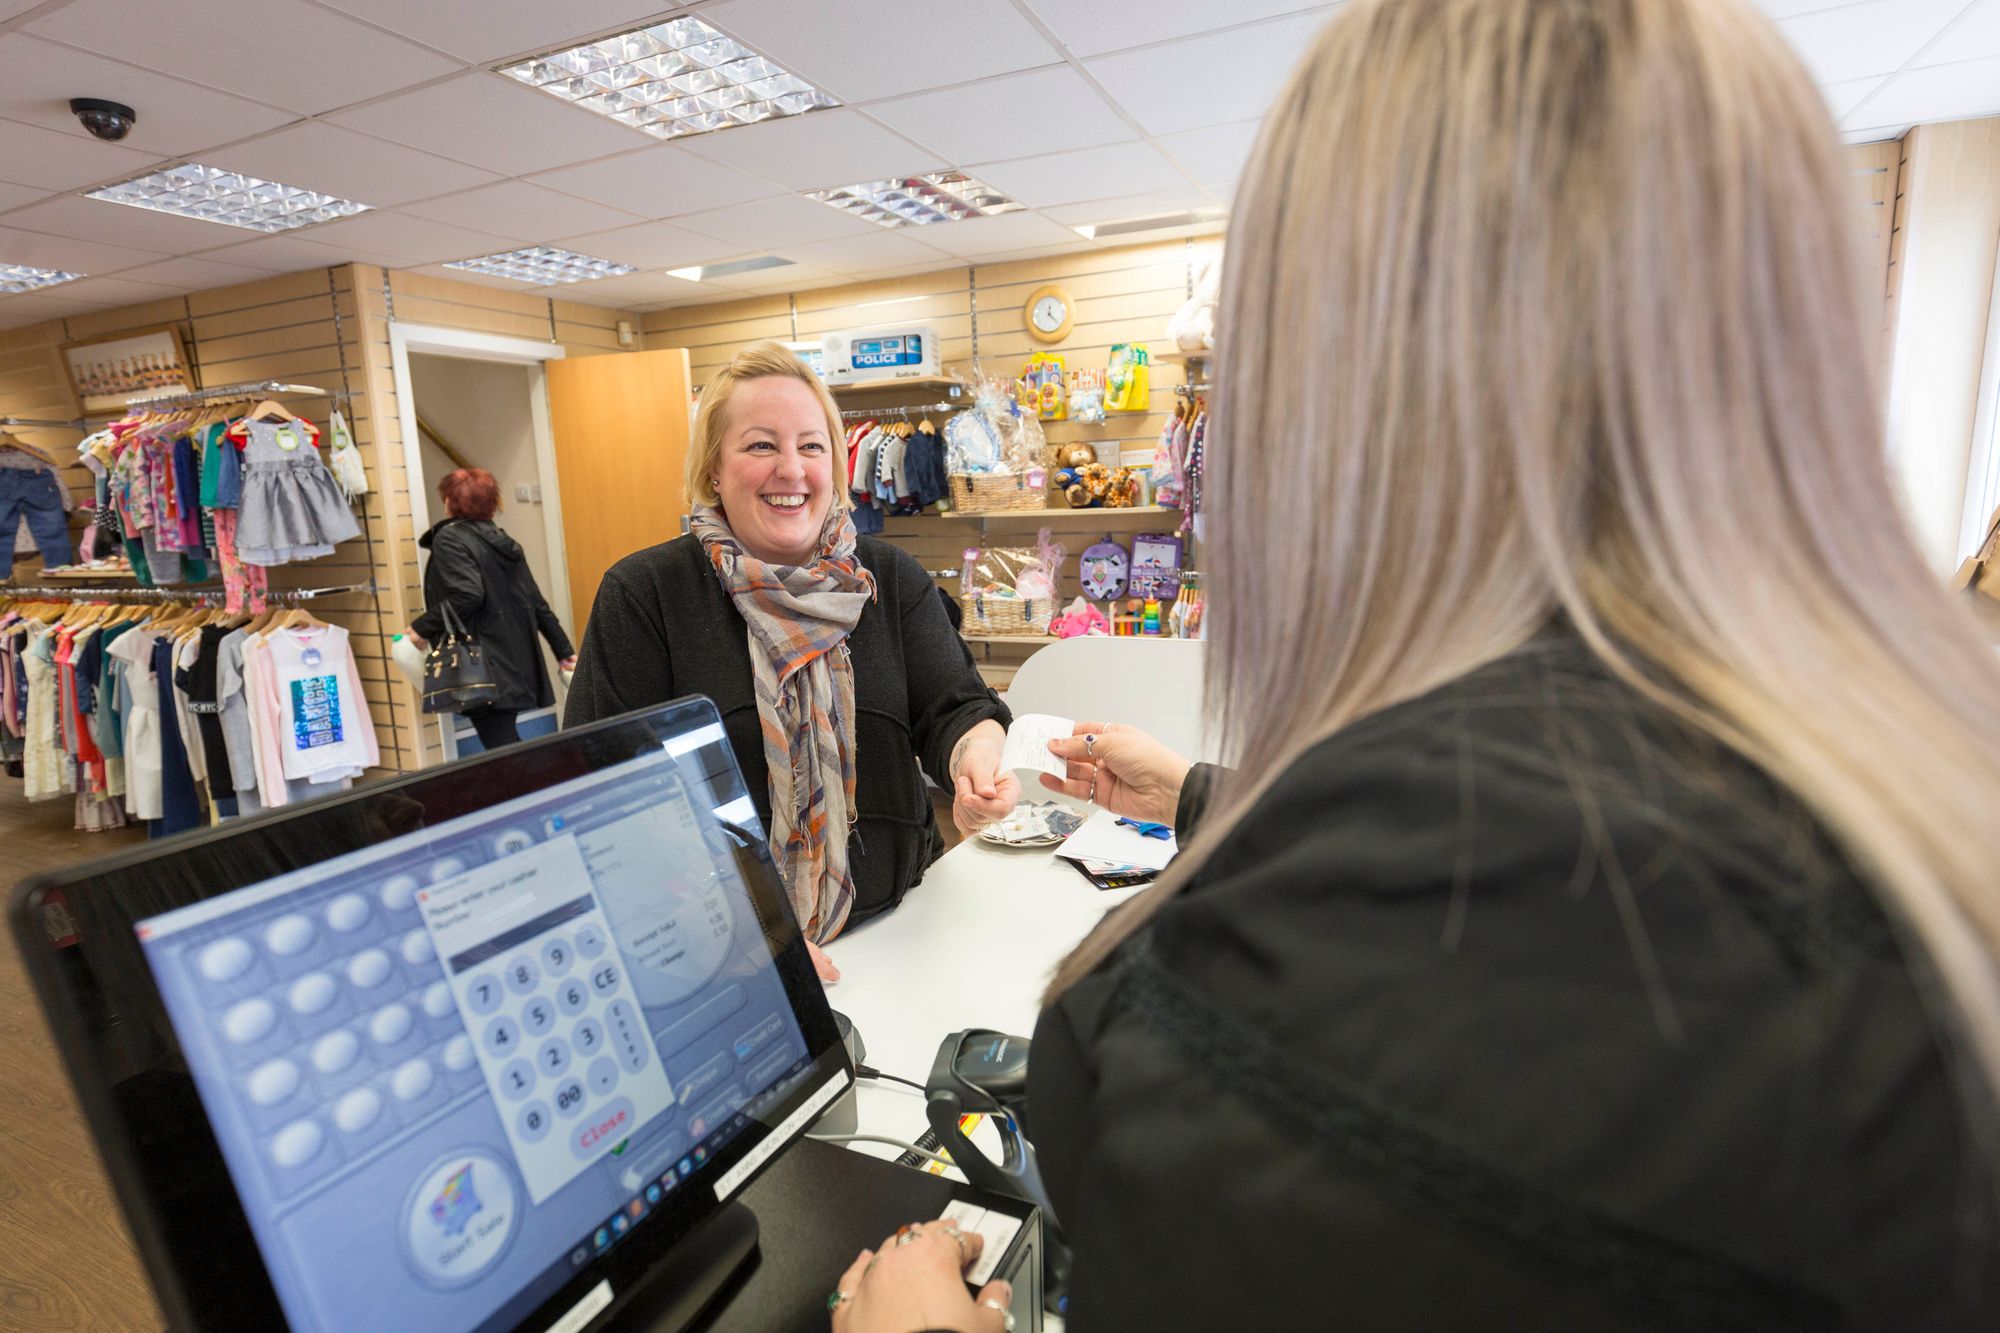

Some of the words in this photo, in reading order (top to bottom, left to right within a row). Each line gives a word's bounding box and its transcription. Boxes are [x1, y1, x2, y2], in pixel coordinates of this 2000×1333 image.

[856, 354, 897, 364] POLICE
[302, 677, 333, 747] DANCE
[477, 984, 490, 1004] 7
[516, 965, 530, 984] 8
[551, 948, 564, 966] 9
[495, 1028, 509, 1045] 4
[532, 1006, 546, 1026] 5
[567, 988, 580, 1006] 6
[595, 967, 617, 990] CE
[511, 1071, 525, 1090] 1
[548, 1048, 562, 1067] 2
[581, 1028, 595, 1046] 3
[527, 1111, 541, 1130] 0
[557, 1084, 582, 1111] 00
[580, 1109, 626, 1149] Close
